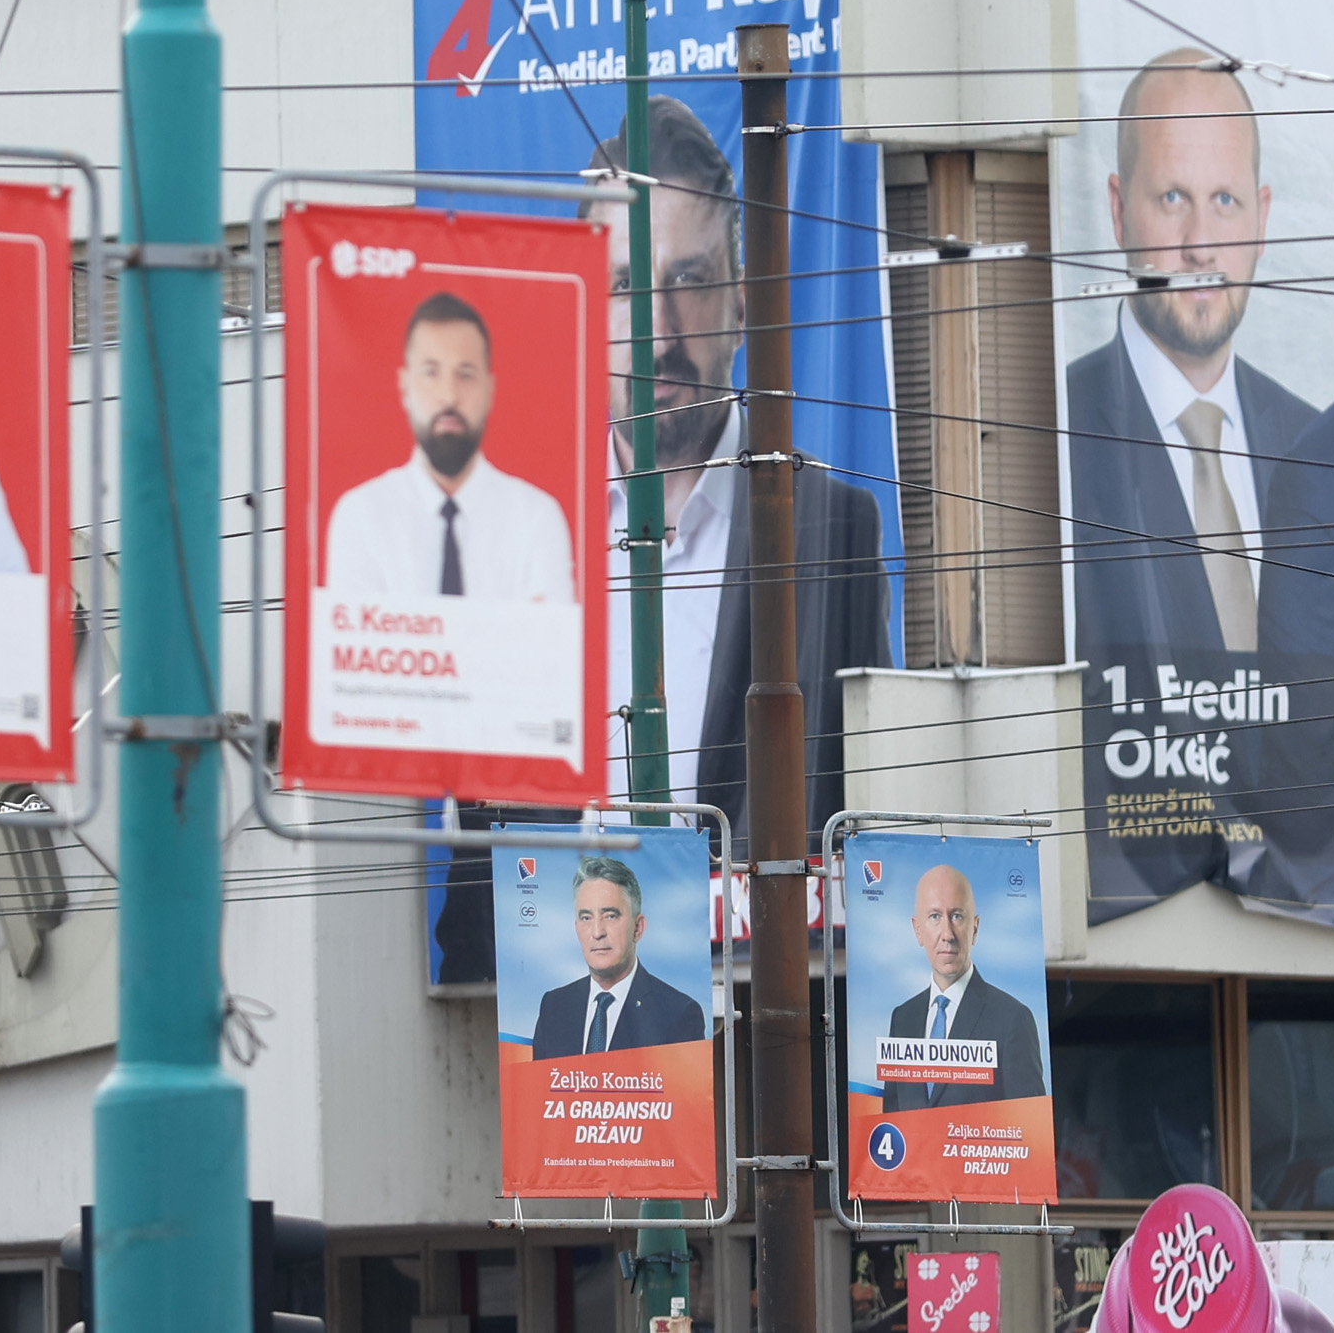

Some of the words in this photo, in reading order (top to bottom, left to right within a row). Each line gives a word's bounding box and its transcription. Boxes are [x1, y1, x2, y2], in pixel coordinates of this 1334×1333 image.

[519, 47, 626, 93] Kandida
[649, 48, 676, 77] za
[333, 604, 355, 632] 6.
[361, 606, 444, 635] Kenan
[334, 646, 457, 677] MAGODA
[1103, 665, 1145, 714] 1.
[1106, 788, 1215, 814] SKUPŠTIN
[1108, 817, 1212, 837] KANTONA
[881, 1043, 924, 1061] MILAN
[929, 1042, 993, 1063] DUNOVIĆ
[550, 1068, 598, 1092] Željko
[602, 1072, 663, 1090] Komšić
[881, 1068, 911, 1078] Kandidat
[923, 1069, 951, 1079] državni
[953, 1070, 990, 1081] parlament
[543, 1101, 565, 1119] ZA
[569, 1101, 672, 1120] GRAĐANSKU
[575, 1121, 643, 1144] DRŽAVU
[947, 1123, 980, 1139] Željko
[982, 1125, 1022, 1139] Komšić
[877, 1133, 894, 1161] 4
[942, 1144, 958, 1157] ZA
[960, 1144, 1029, 1159] GRAĐANSKU
[544, 1157, 577, 1166] Kandidat
[588, 1158, 606, 1166] člana
[607, 1158, 660, 1168] Predsjedništva
[661, 1159, 675, 1167] BiH
[963, 1159, 1010, 1175] DRŽAVU
[1151, 1211, 1213, 1283] sky
[1154, 1241, 1233, 1329] Cola
